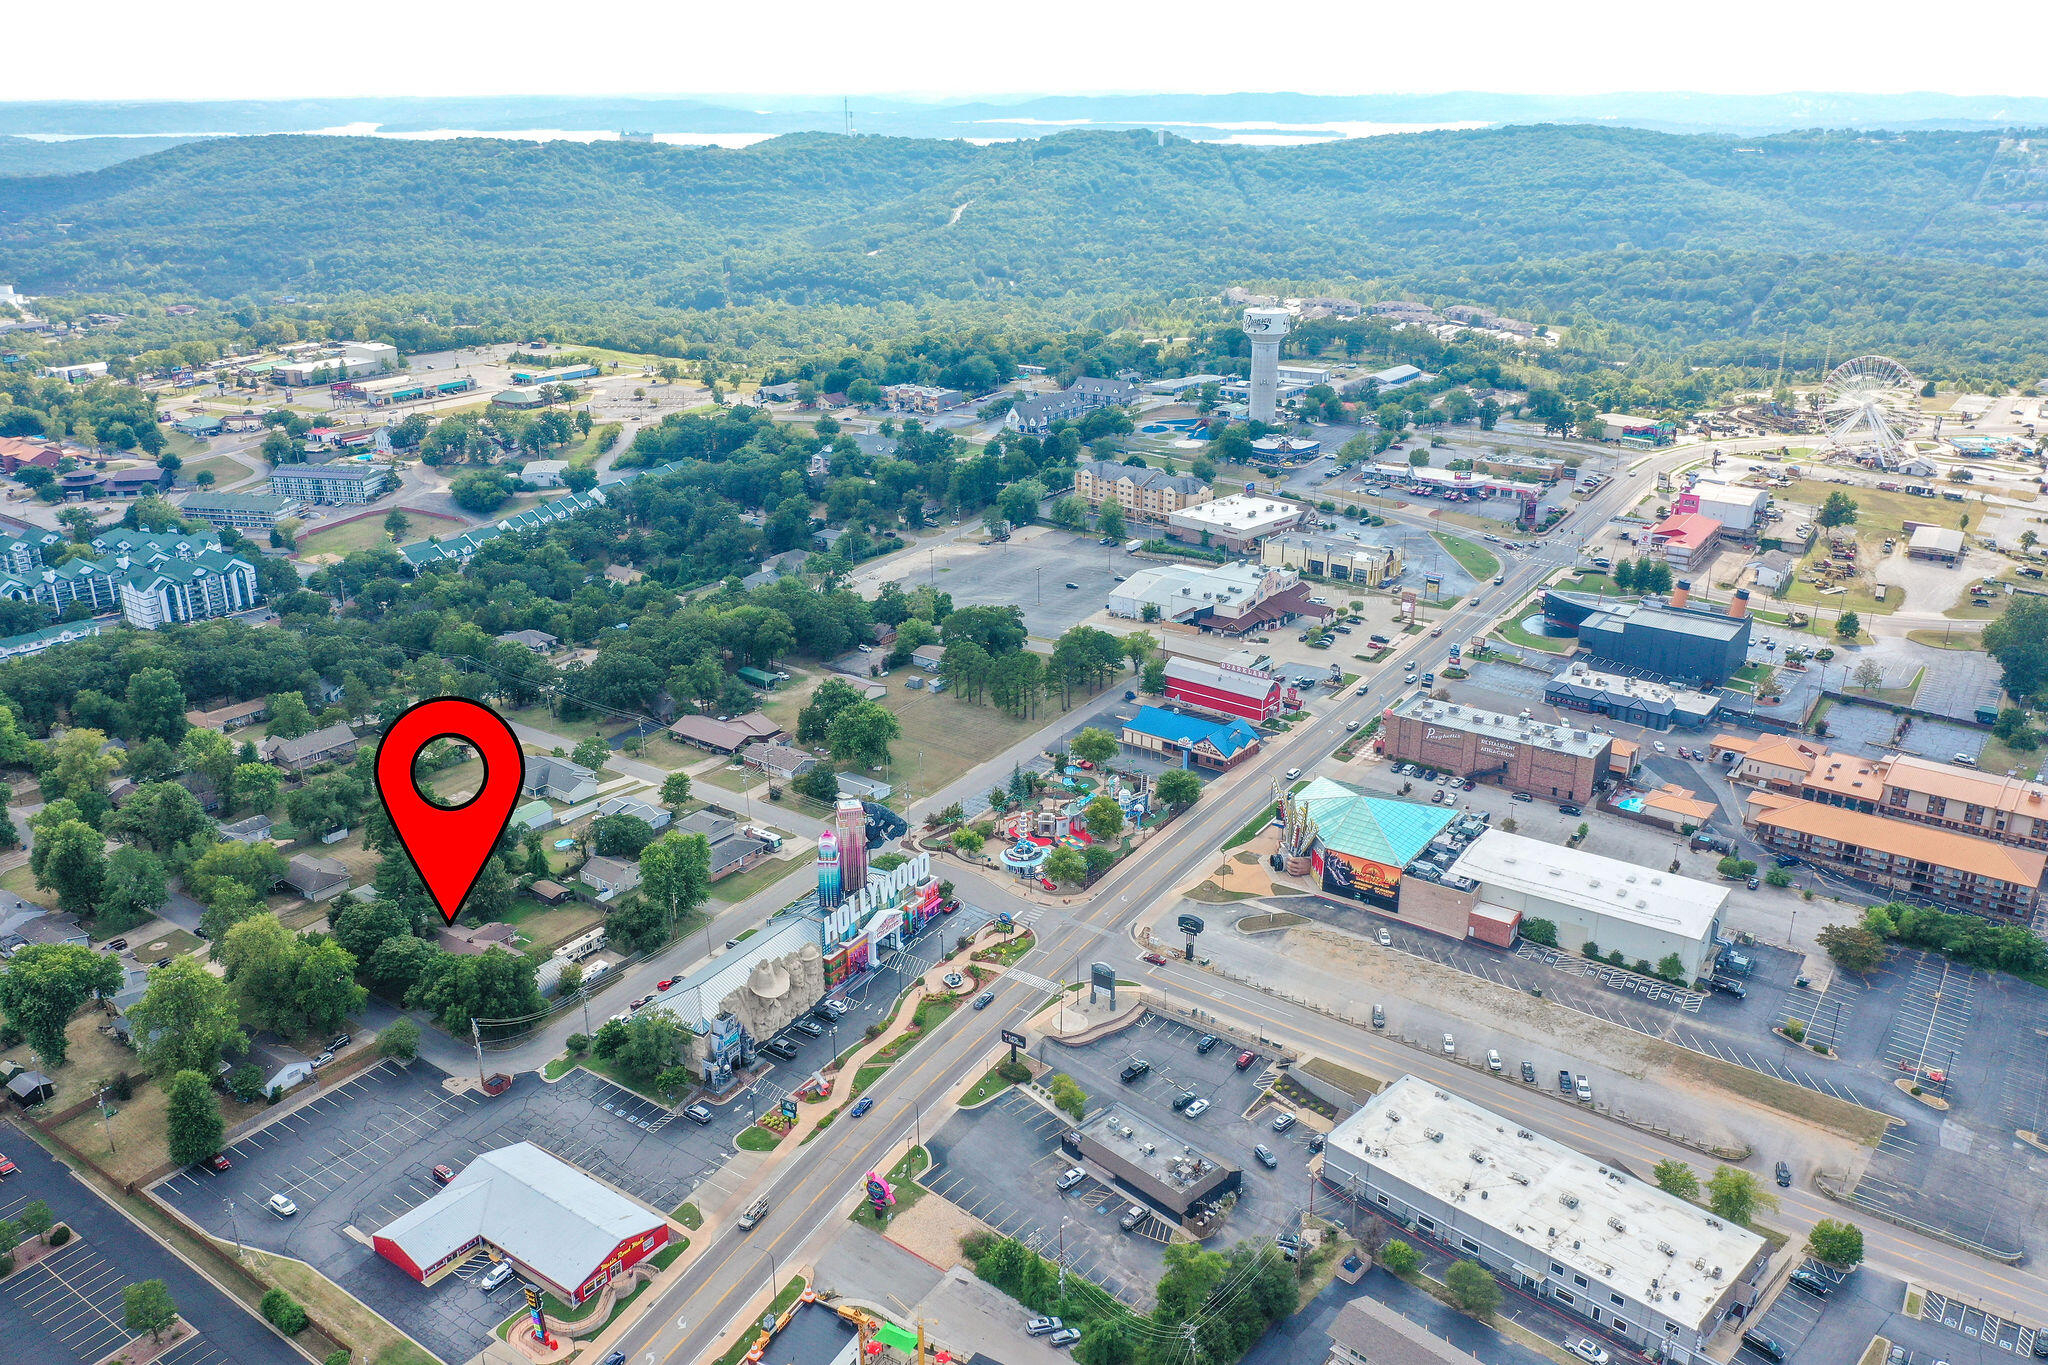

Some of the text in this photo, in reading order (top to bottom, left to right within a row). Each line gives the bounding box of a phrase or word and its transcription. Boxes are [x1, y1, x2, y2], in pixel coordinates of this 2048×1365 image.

[1220, 663, 1270, 680] OZARKLAND
[1480, 739, 1516, 751] RESTAURANT
[1480, 746, 1515, 759] ATTRACTION
[823, 851, 930, 945] HOLLYWOOD
